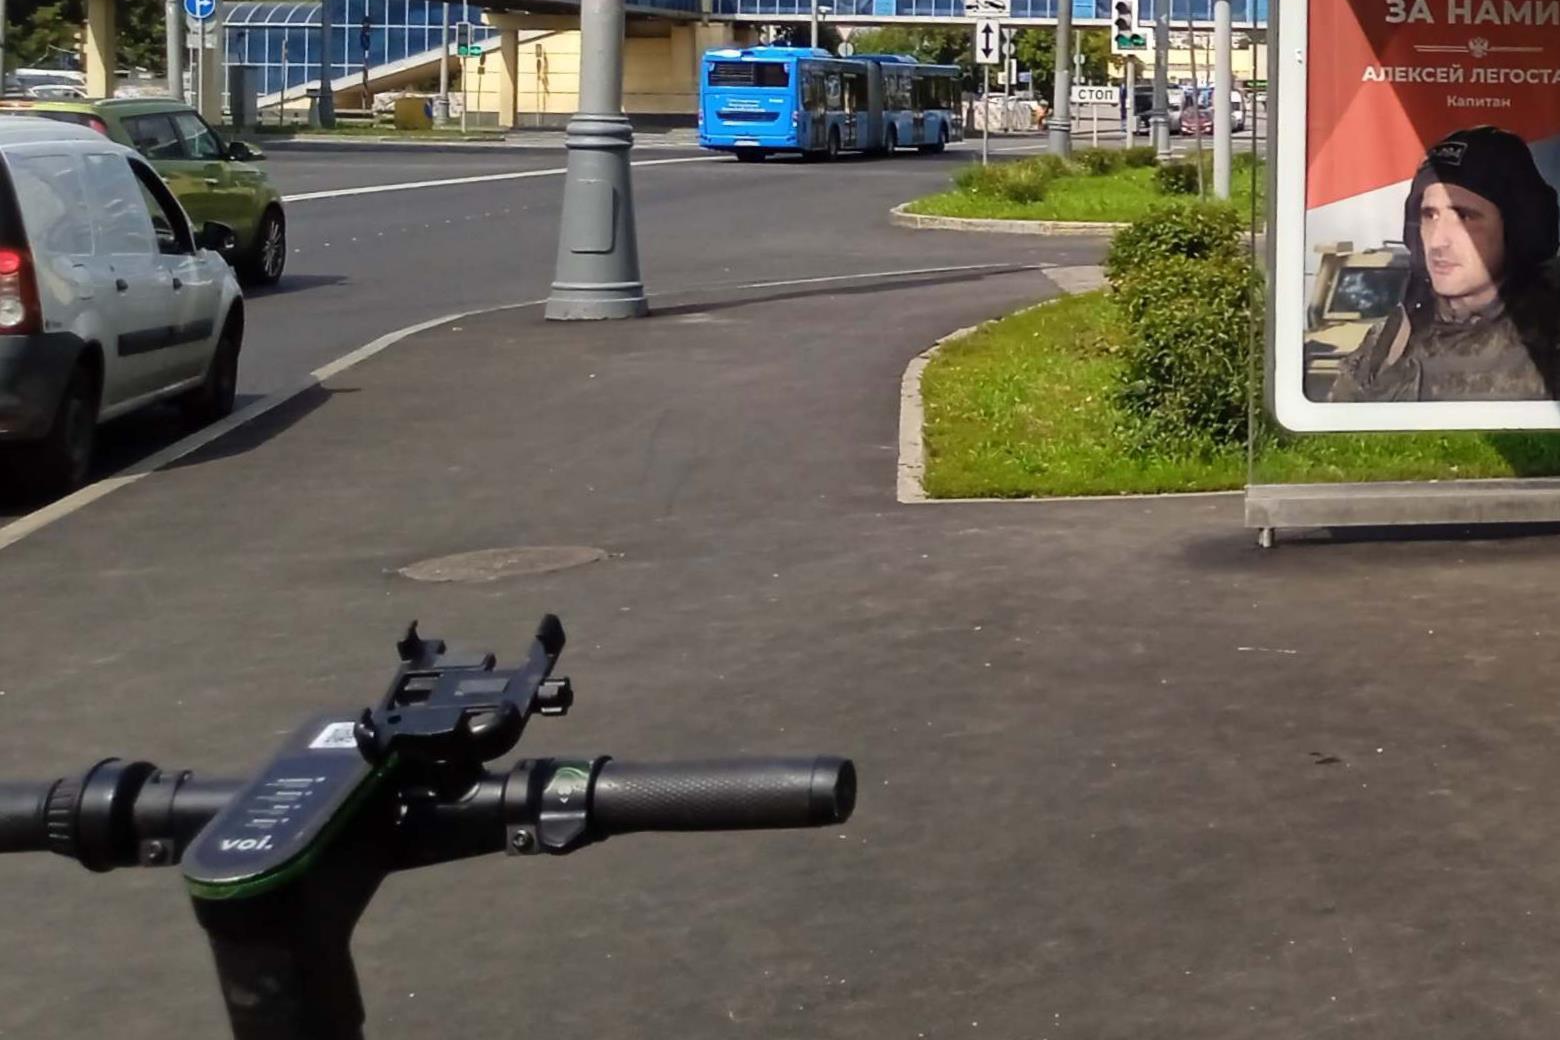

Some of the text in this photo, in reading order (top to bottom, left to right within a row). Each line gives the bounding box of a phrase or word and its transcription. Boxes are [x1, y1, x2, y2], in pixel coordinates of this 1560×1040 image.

[1361, 65, 1464, 84] АЛЕКСЕЙ
[1078, 89, 1113, 101] СТОП
[1447, 95, 1511, 109] Капитан
